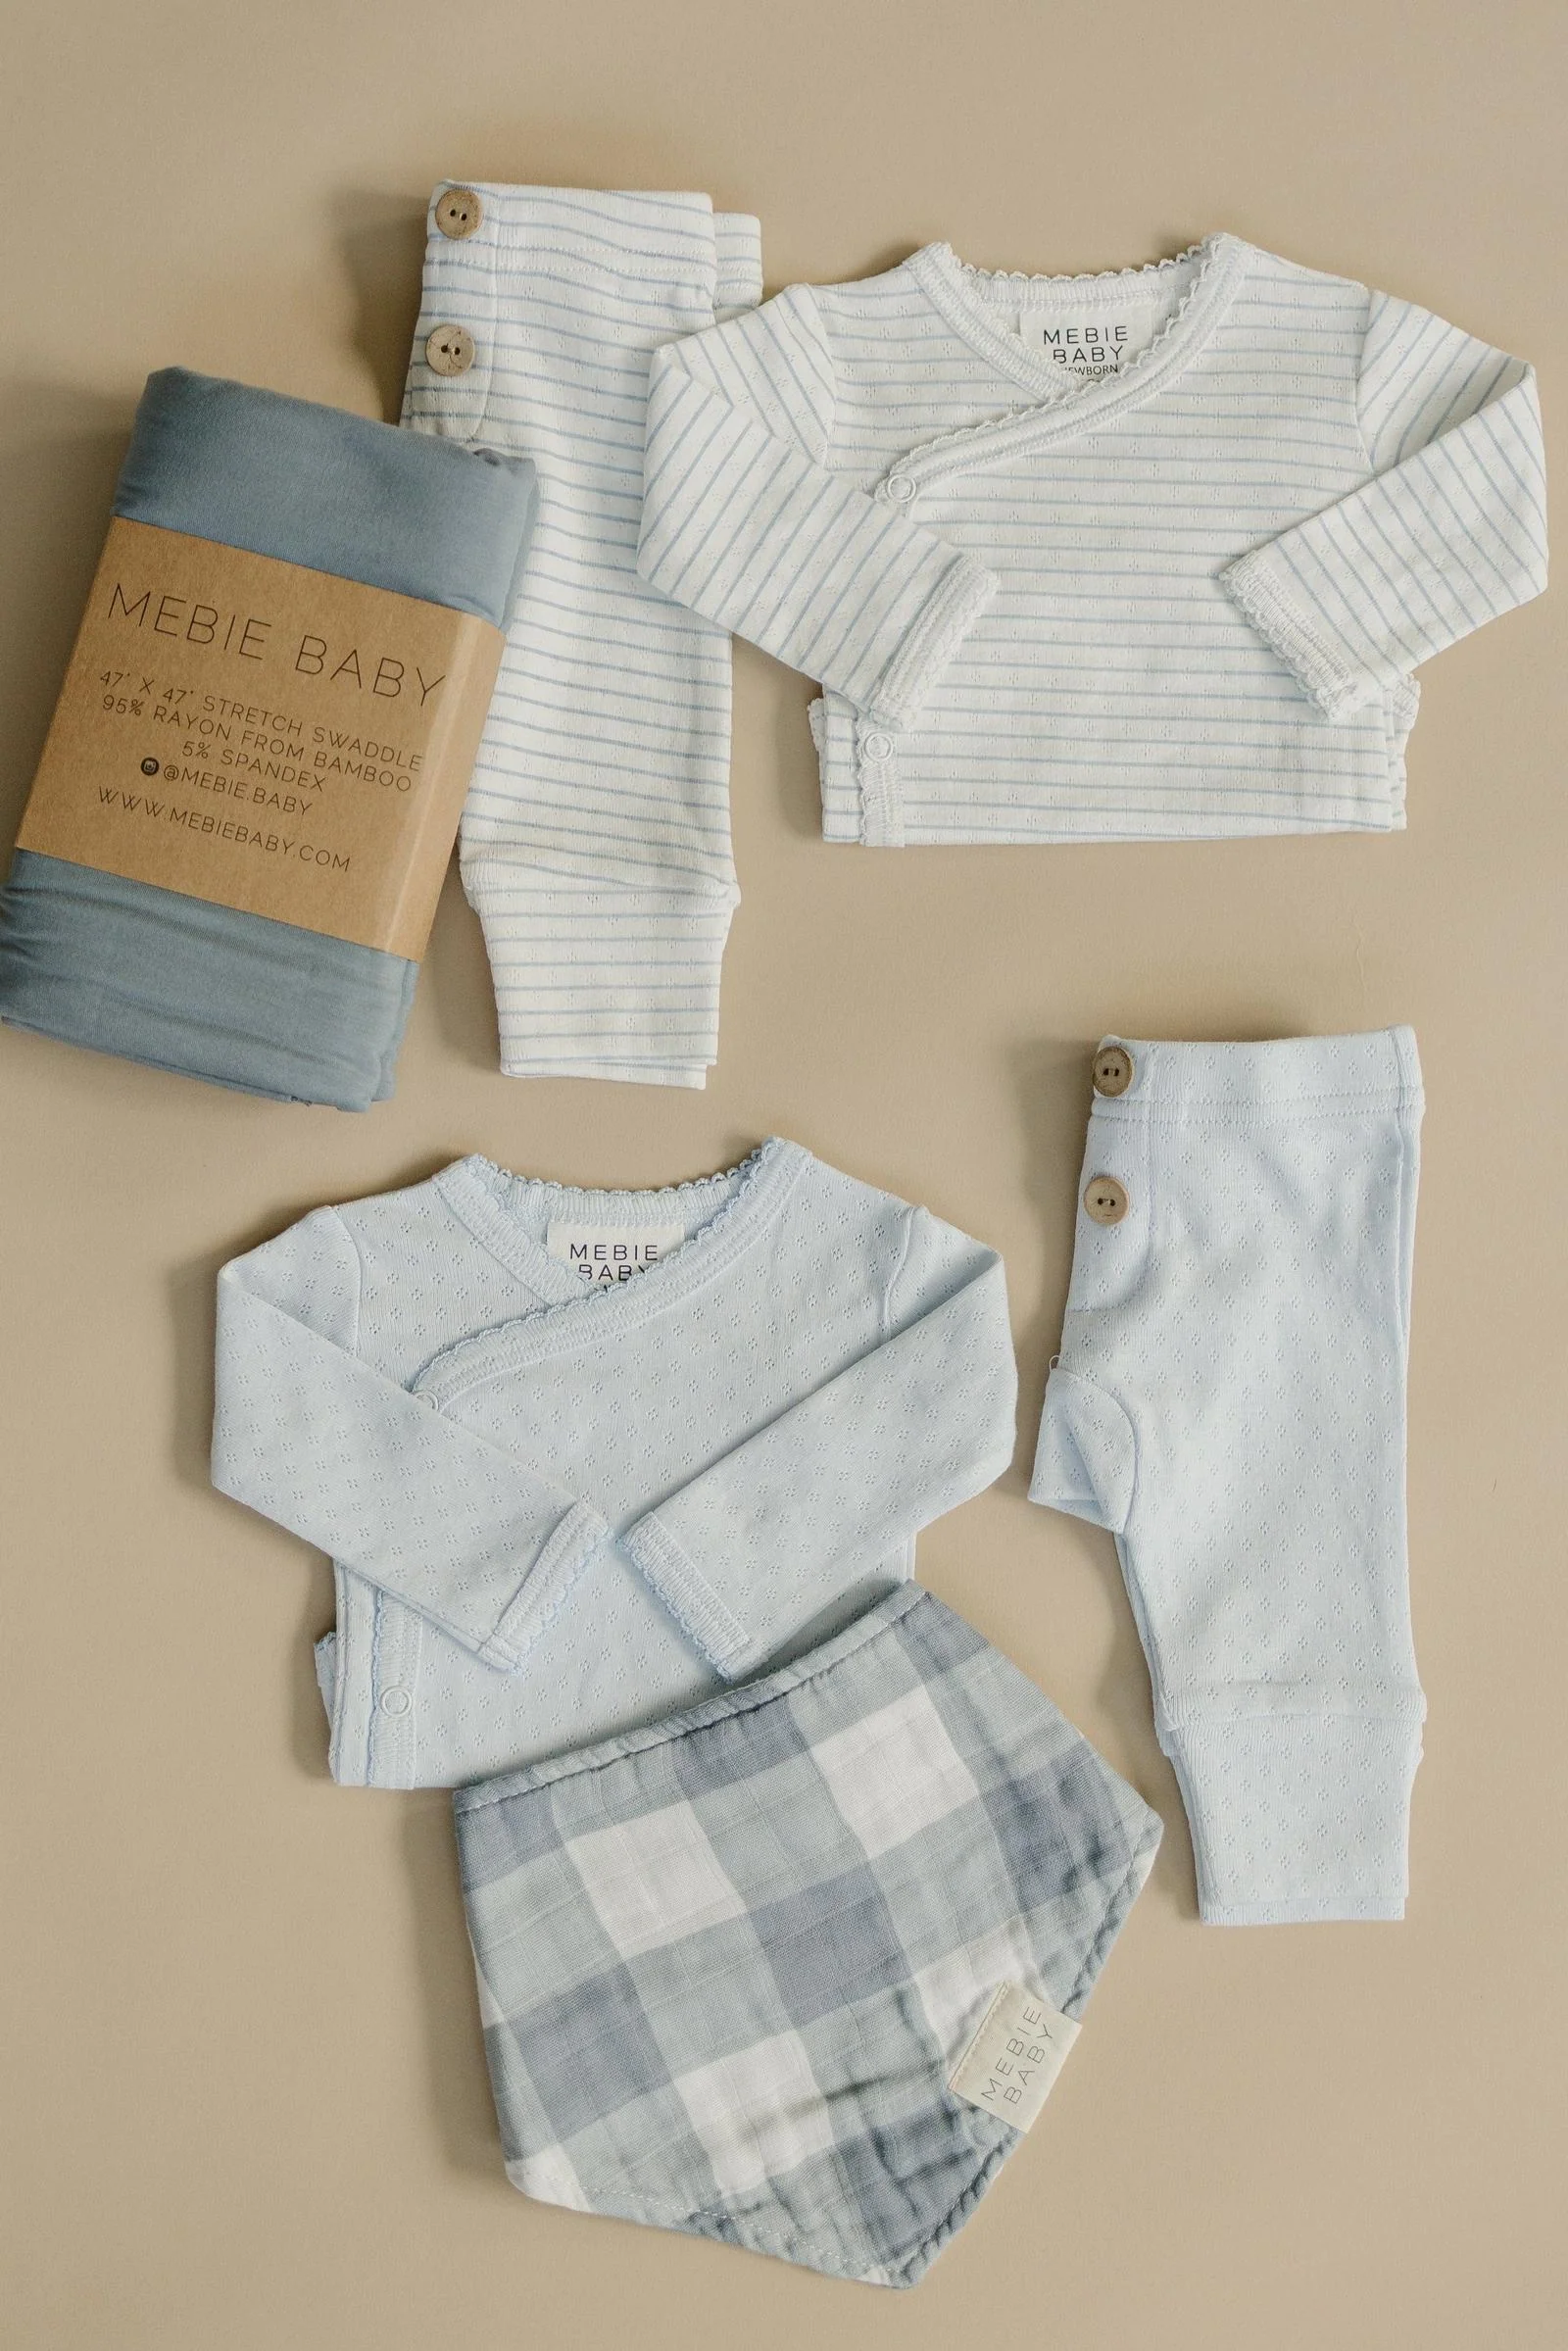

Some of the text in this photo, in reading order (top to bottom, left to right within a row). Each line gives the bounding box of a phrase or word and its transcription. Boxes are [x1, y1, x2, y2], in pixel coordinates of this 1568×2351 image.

[1043, 325, 1128, 345] MEBIE
[1053, 345, 1123, 364] BABY
[1064, 364, 1119, 375] WBORN
[108, 584, 446, 707] MEBIE BABY
[102, 694, 412, 792] 95% RAYON FROM BAMBOO
[202, 695, 304, 737] STRETCH
[312, 726, 423, 772] SWADDLE
[163, 764, 314, 816] @MEBIE.BABY
[181, 740, 327, 793] 5% SPANDEX
[98, 785, 351, 873] WWW.MEBIEBABY.COM
[569, 1243, 659, 1261] MEBIE
[980, 2006, 1042, 2101] MEBIE
[1003, 2023, 1054, 2105] BABY
